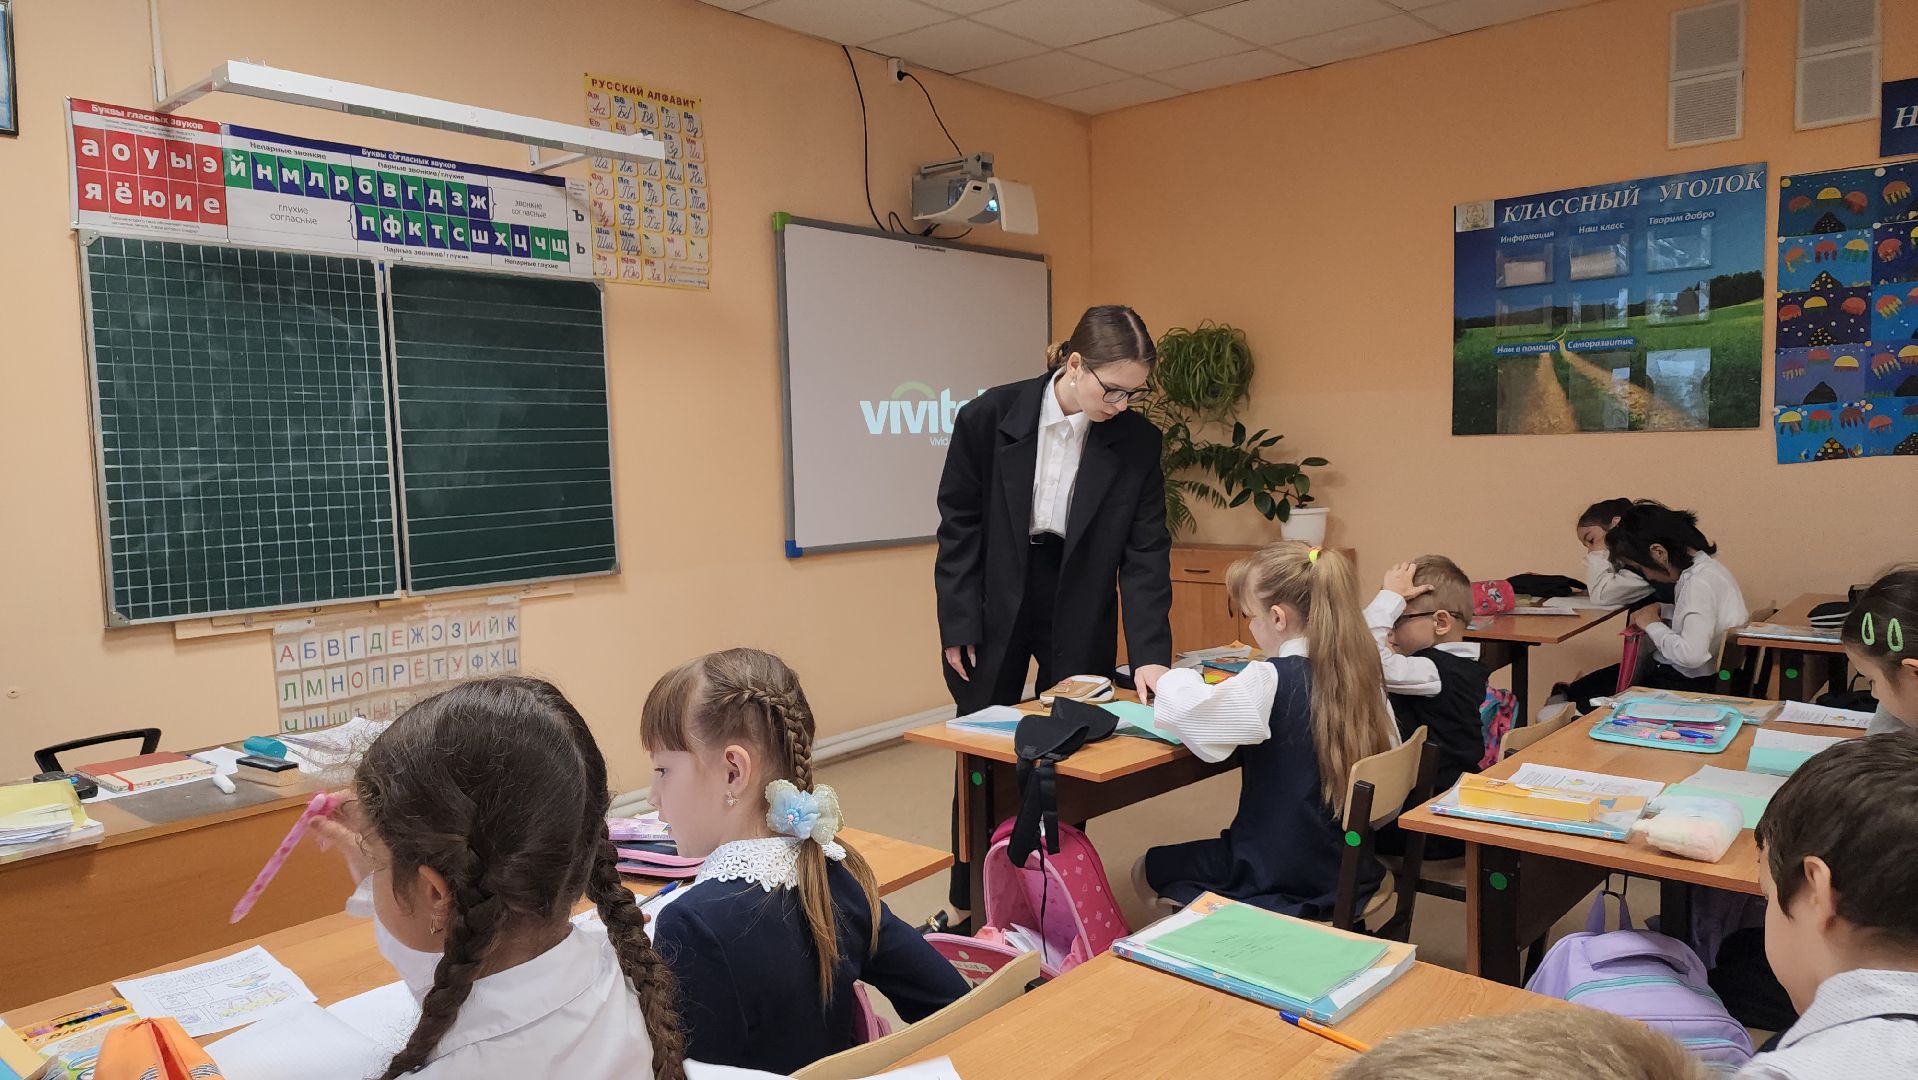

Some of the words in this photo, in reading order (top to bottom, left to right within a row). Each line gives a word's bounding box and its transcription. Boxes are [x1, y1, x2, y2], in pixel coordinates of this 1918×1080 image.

[591, 78, 644, 97] РУССКИЙ
[647, 90, 696, 109] АЛФАВИТ
[91, 103, 124, 117] Буквы
[127, 111, 168, 124] гласных
[170, 118, 204, 130] звуков
[81, 138, 100, 158] а
[112, 144, 130, 162] о
[143, 147, 160, 170] у
[170, 152, 193, 170] ы
[202, 157, 217, 174] э
[249, 141, 292, 155] Непарные
[230, 153, 246, 177] й
[256, 164, 272, 180] н
[282, 168, 300, 184] м
[308, 172, 324, 188] л
[334, 175, 350, 196] р
[358, 175, 373, 194] б
[383, 182, 396, 197] в
[407, 186, 418, 200] г
[428, 188, 444, 206] д
[452, 192, 463, 207] з
[470, 194, 488, 210] ж
[85, 182, 102, 201] я
[115, 181, 133, 204] ё
[143, 190, 166, 208] ю
[176, 193, 192, 212] и
[204, 197, 220, 214] е
[278, 204, 309, 215] глухие
[1502, 184, 1641, 224] КЛАССНЫЙ
[1659, 170, 1765, 203] УГОЛОК
[270, 213, 318, 224] согласные
[1578, 224, 1598, 234] Наш
[1600, 222, 1625, 232] класс
[1648, 214, 1684, 226] Творим
[1684, 209, 1715, 222] добро
[362, 216, 376, 232] п
[383, 215, 402, 236] ф
[408, 222, 421, 236] к
[432, 224, 444, 239] т
[452, 226, 464, 242] с
[472, 228, 489, 244] ш
[494, 232, 508, 246] х
[514, 234, 528, 251] ц
[534, 236, 546, 250] ч
[552, 238, 568, 256] щ
[1500, 230, 1554, 244] Информация
[1567, 337, 1634, 350] Саморазвитие
[280, 645, 295, 663] А
[304, 641, 317, 660] Б
[327, 638, 340, 656] В
[350, 635, 360, 654] Г
[370, 632, 382, 653] Д
[392, 630, 404, 647] Е
[411, 626, 424, 644] Ж
[451, 622, 461, 638] З
[470, 620, 480, 636] И
[489, 616, 499, 634] Й
[508, 616, 516, 632] К
[284, 682, 297, 701] Л
[306, 678, 322, 696] М
[331, 674, 344, 692] Н
[352, 672, 363, 688] О
[372, 666, 384, 684] П
[393, 664, 404, 680] Р
[414, 658, 424, 678] Ё
[432, 658, 444, 674] Т
[452, 656, 462, 672] У
[472, 654, 484, 670] Ф
[490, 650, 501, 668] Х
[507, 648, 517, 667] Ц
